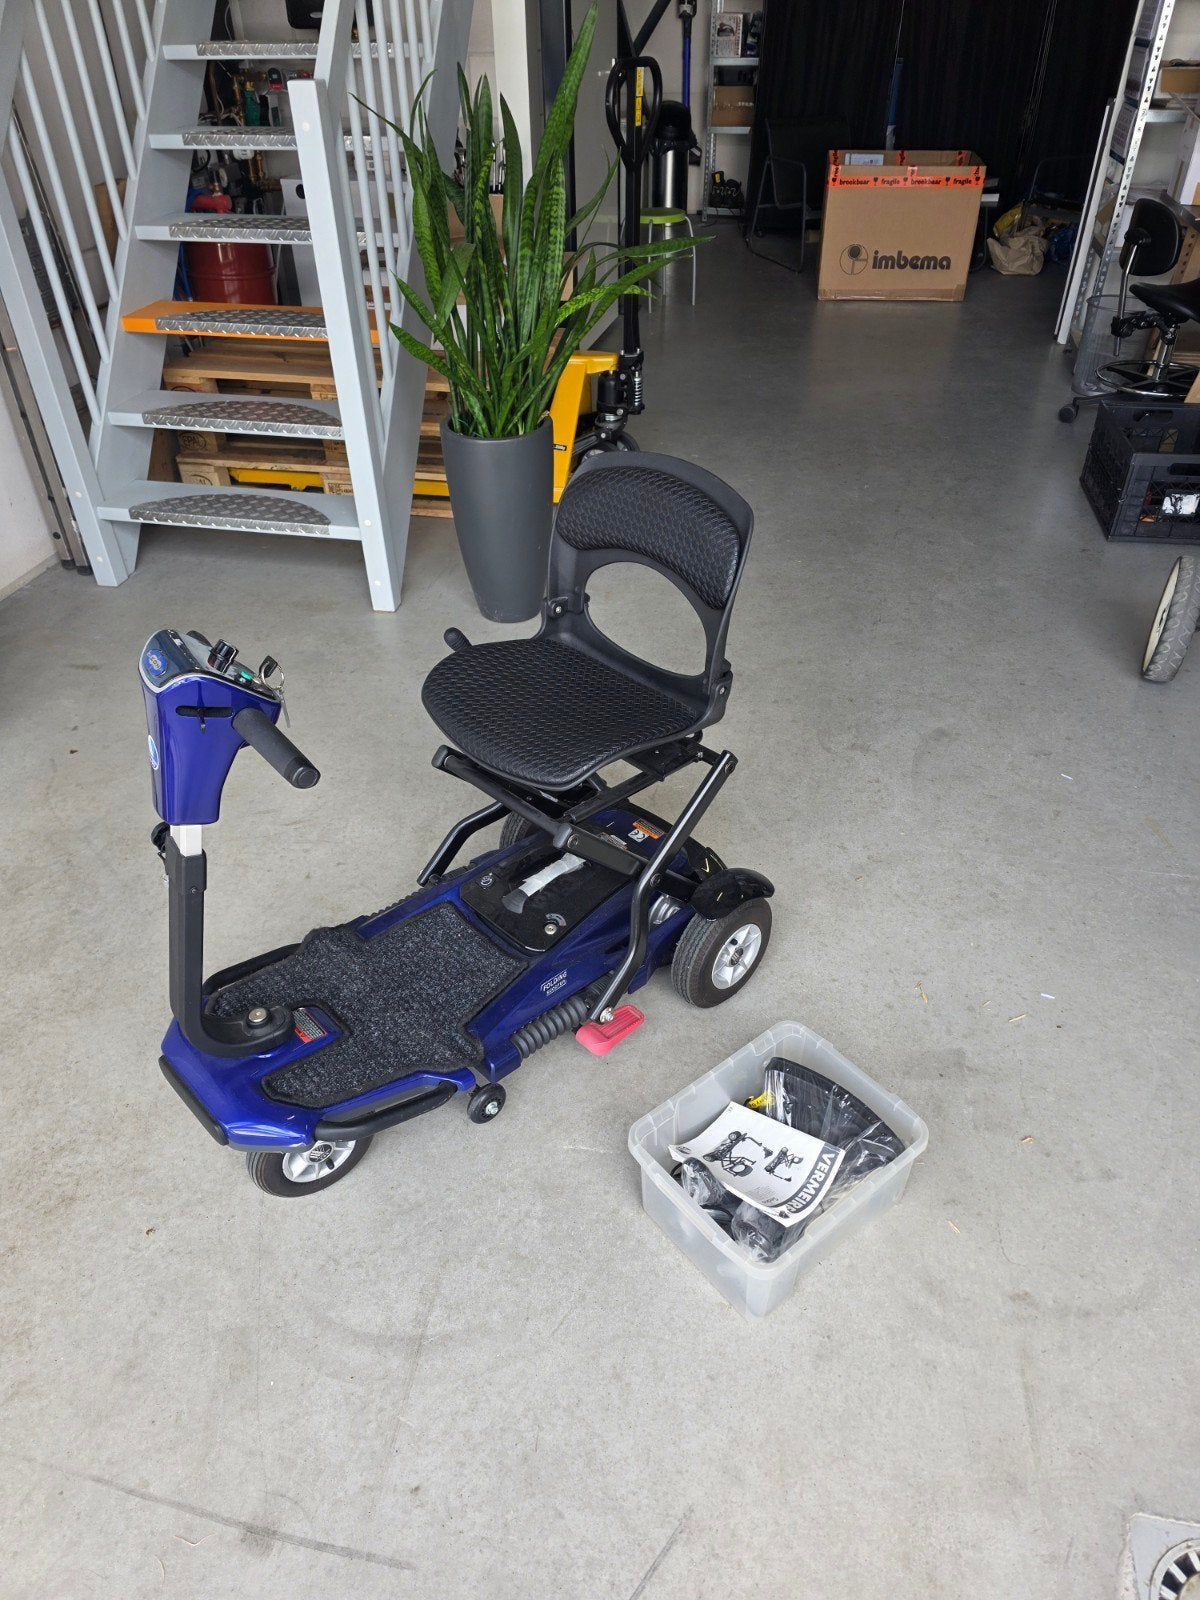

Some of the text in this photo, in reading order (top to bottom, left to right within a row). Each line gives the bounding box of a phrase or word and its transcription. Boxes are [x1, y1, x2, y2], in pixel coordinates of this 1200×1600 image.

[881, 178, 900, 186] fragile
[953, 178, 972, 186] fragile
[872, 250, 952, 270] imbema
